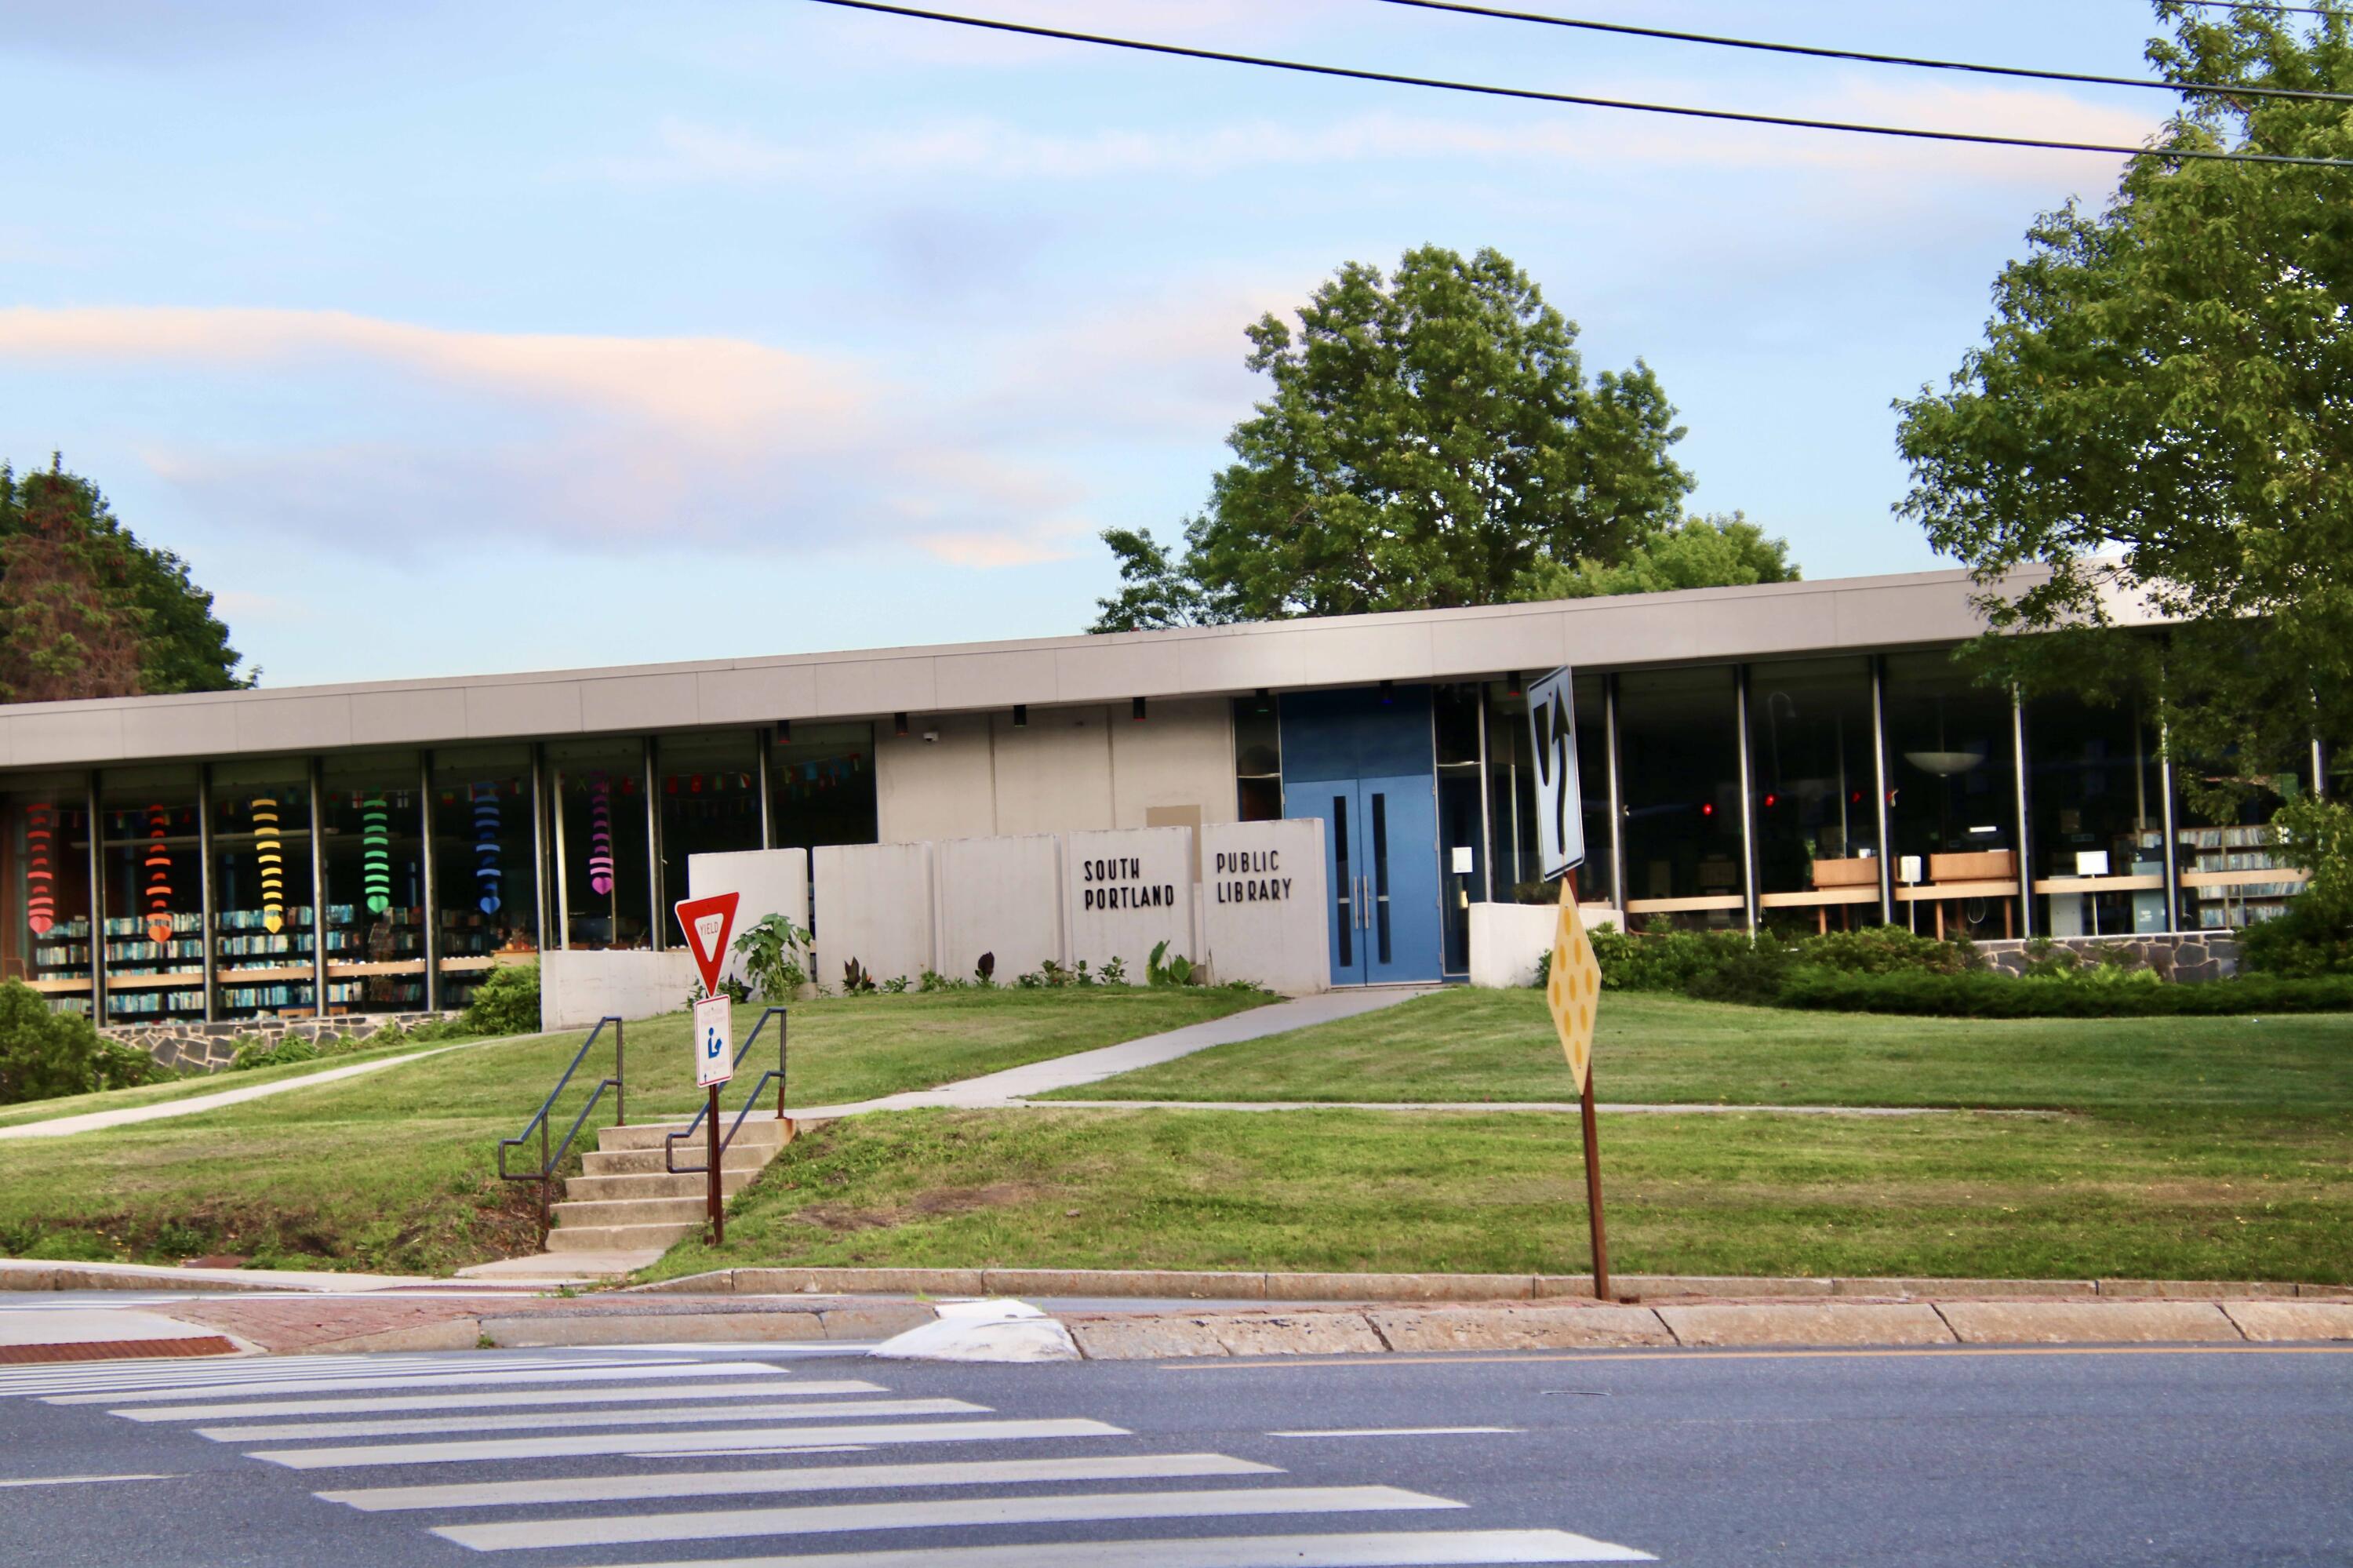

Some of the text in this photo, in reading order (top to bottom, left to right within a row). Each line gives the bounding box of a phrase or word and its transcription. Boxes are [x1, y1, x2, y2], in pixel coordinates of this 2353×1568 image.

[1084, 858, 1140, 882] SOUTH
[1217, 850, 1278, 874] PUBLIC
[1085, 885, 1174, 911] PORTLAND
[1217, 878, 1292, 903] LIBRARY
[700, 922, 719, 936] YIELD
